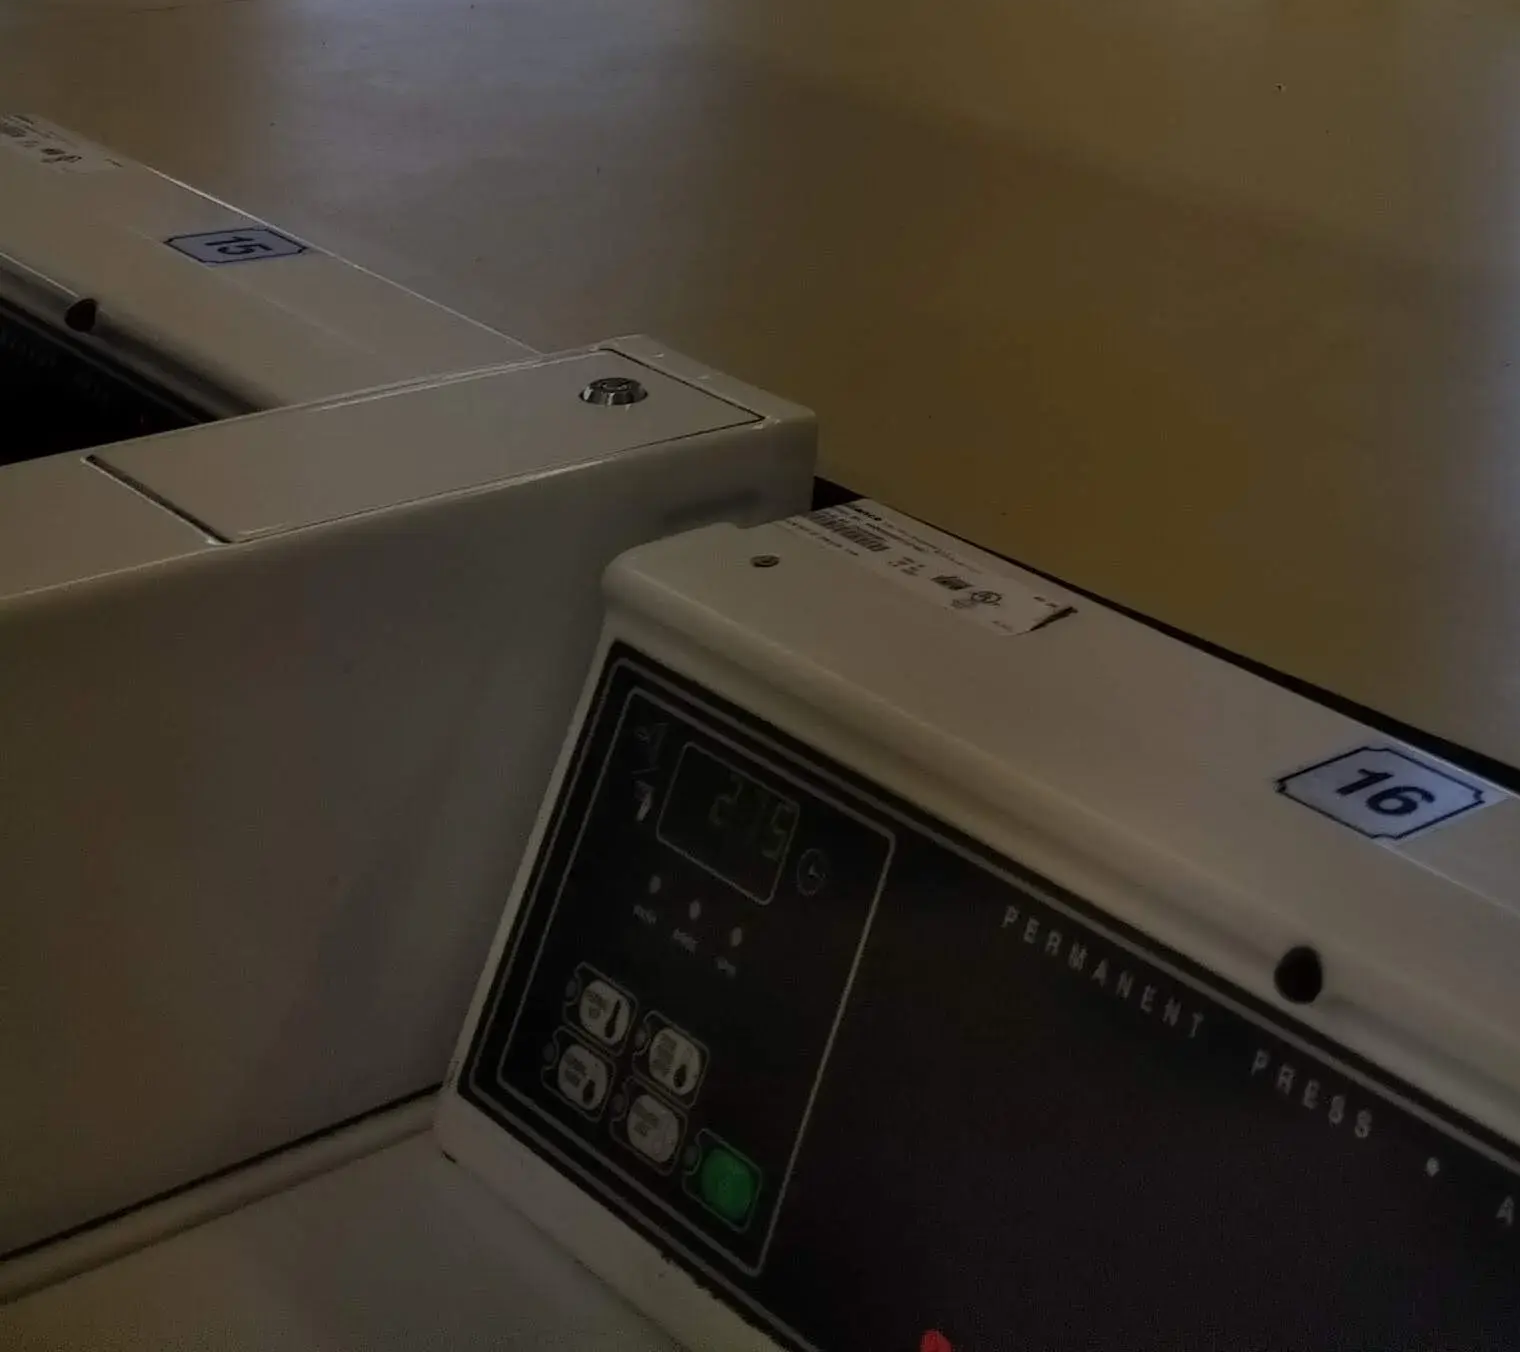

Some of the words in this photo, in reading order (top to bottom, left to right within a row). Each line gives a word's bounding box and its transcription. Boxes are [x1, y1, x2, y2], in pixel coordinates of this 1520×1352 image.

[204, 236, 272, 255] 15
[1336, 768, 1435, 816] 16
[1001, 904, 1206, 1039] PERMANENT
[1250, 1048, 1374, 1139] PRESS
